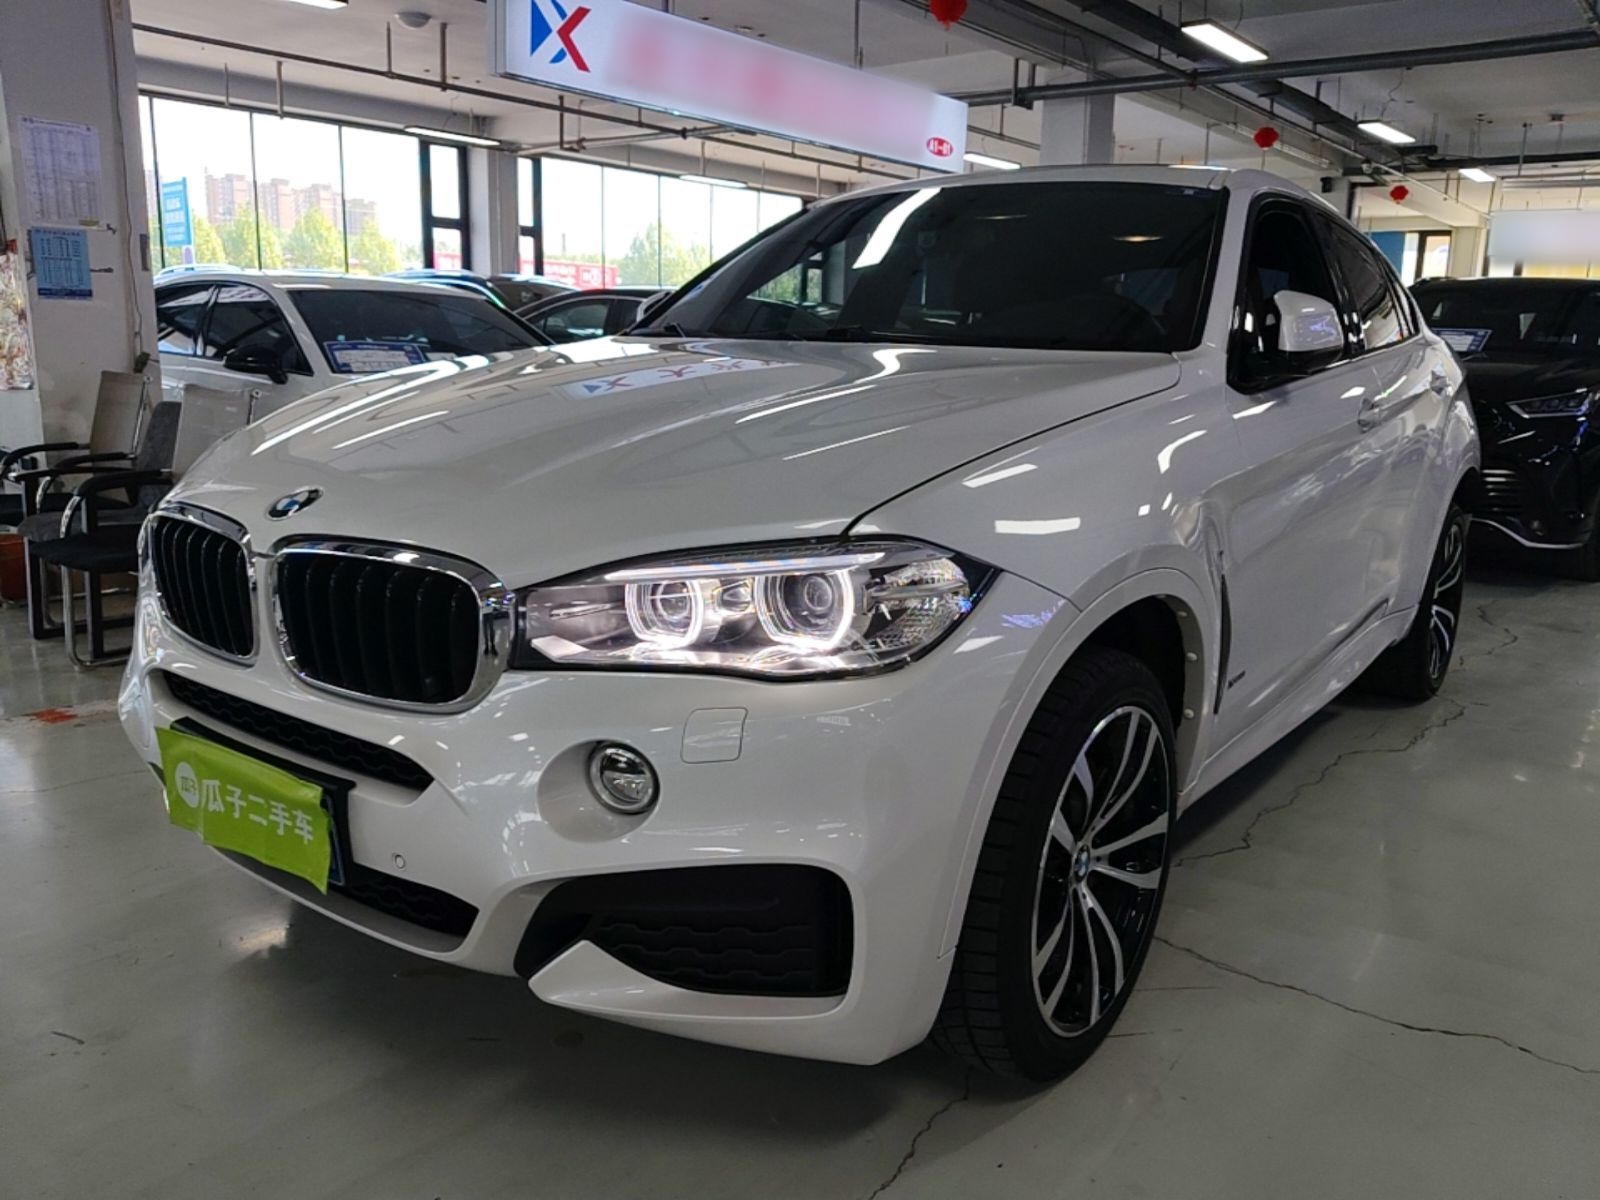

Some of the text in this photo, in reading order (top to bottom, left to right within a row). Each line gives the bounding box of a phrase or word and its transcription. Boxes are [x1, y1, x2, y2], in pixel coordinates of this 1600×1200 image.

[202, 779, 314, 844] 瓜子二手车
